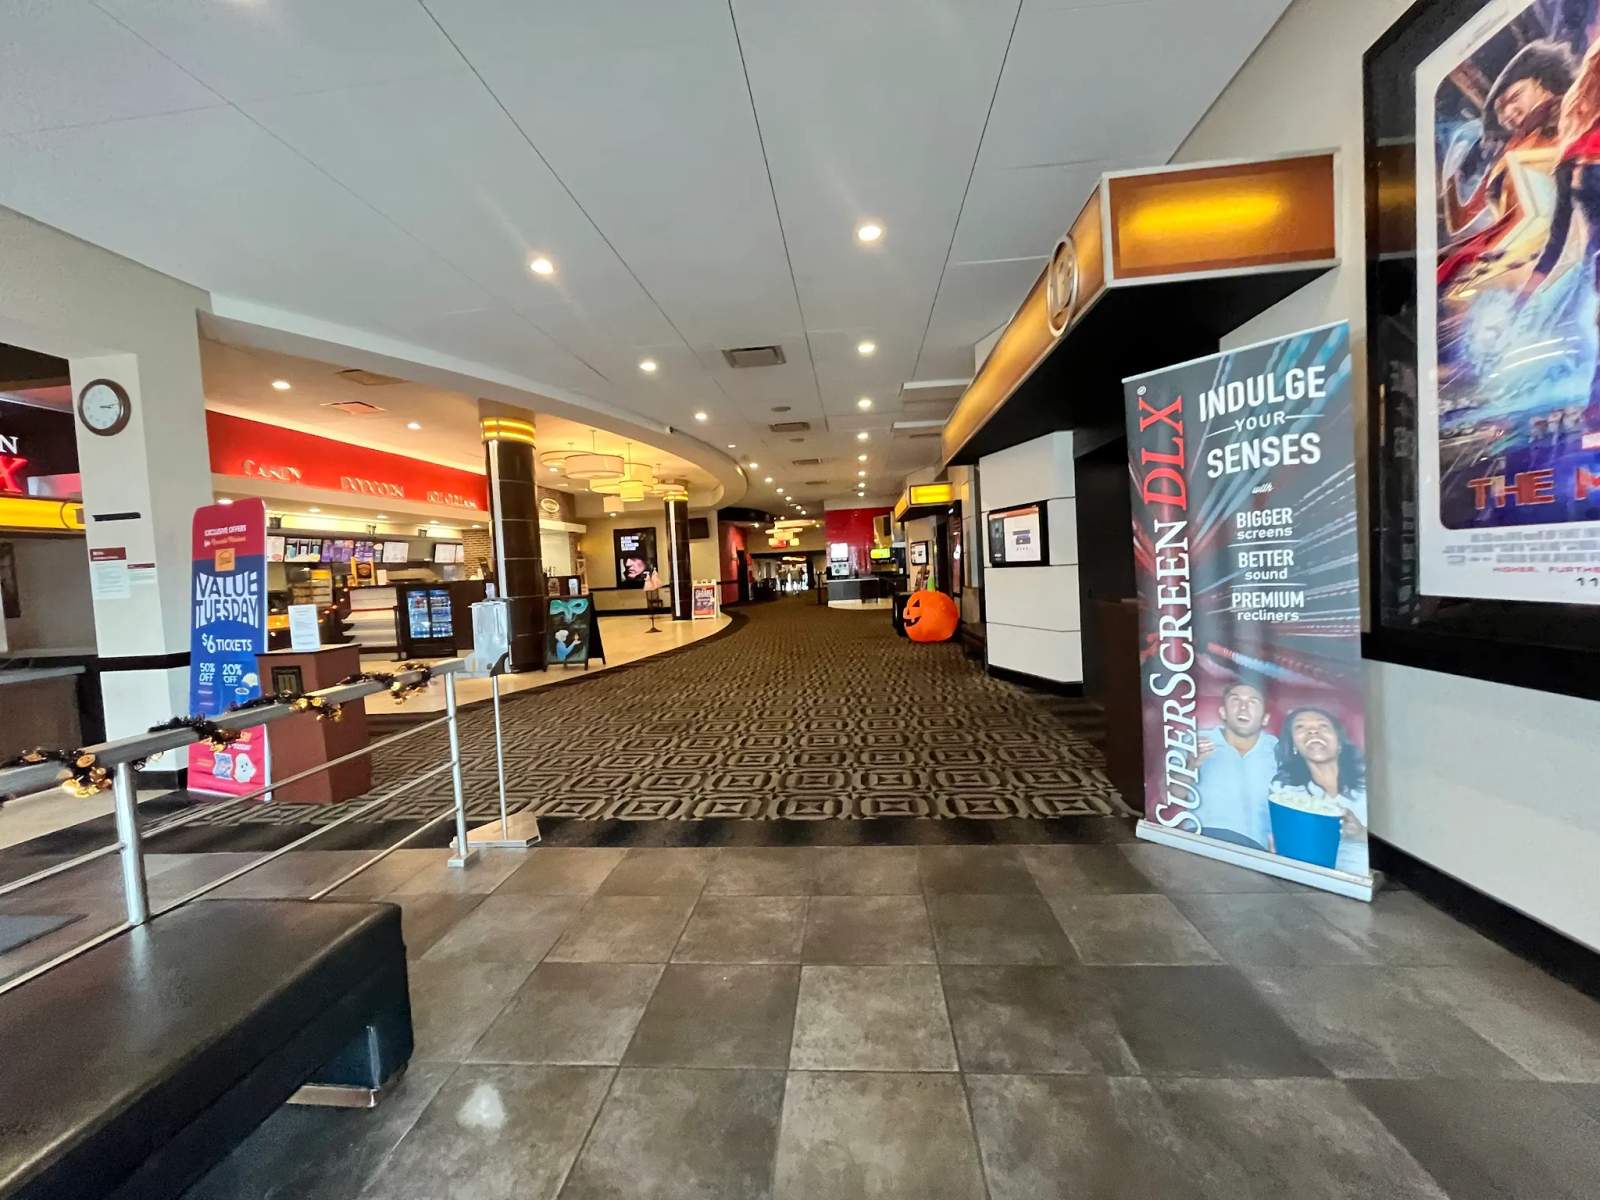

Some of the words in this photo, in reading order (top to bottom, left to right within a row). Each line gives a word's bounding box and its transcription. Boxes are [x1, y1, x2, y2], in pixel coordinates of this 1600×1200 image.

[1199, 366, 1327, 422] INDULGE
[1234, 410, 1286, 432] YOUR
[1139, 395, 1188, 511] DLX
[1207, 432, 1321, 479] SENSES
[1466, 467, 1555, 510] THE
[1236, 507, 1293, 529] BIGGER
[1237, 527, 1293, 540] screens
[1238, 549, 1294, 569] BETTER
[1244, 567, 1288, 581] sound
[196, 571, 258, 599] VALUE
[1231, 591, 1305, 608] PREMIUM
[195, 597, 259, 629] TUESDAY
[1237, 609, 1300, 622] recliners
[201, 633, 216, 654] $6
[216, 638, 253, 652] TICKETS
[200, 673, 214, 682] OFF
[222, 664, 242, 676] 20%
[223, 675, 240, 684] OFF
[1150, 519, 1202, 834] SUPERSCREEN
